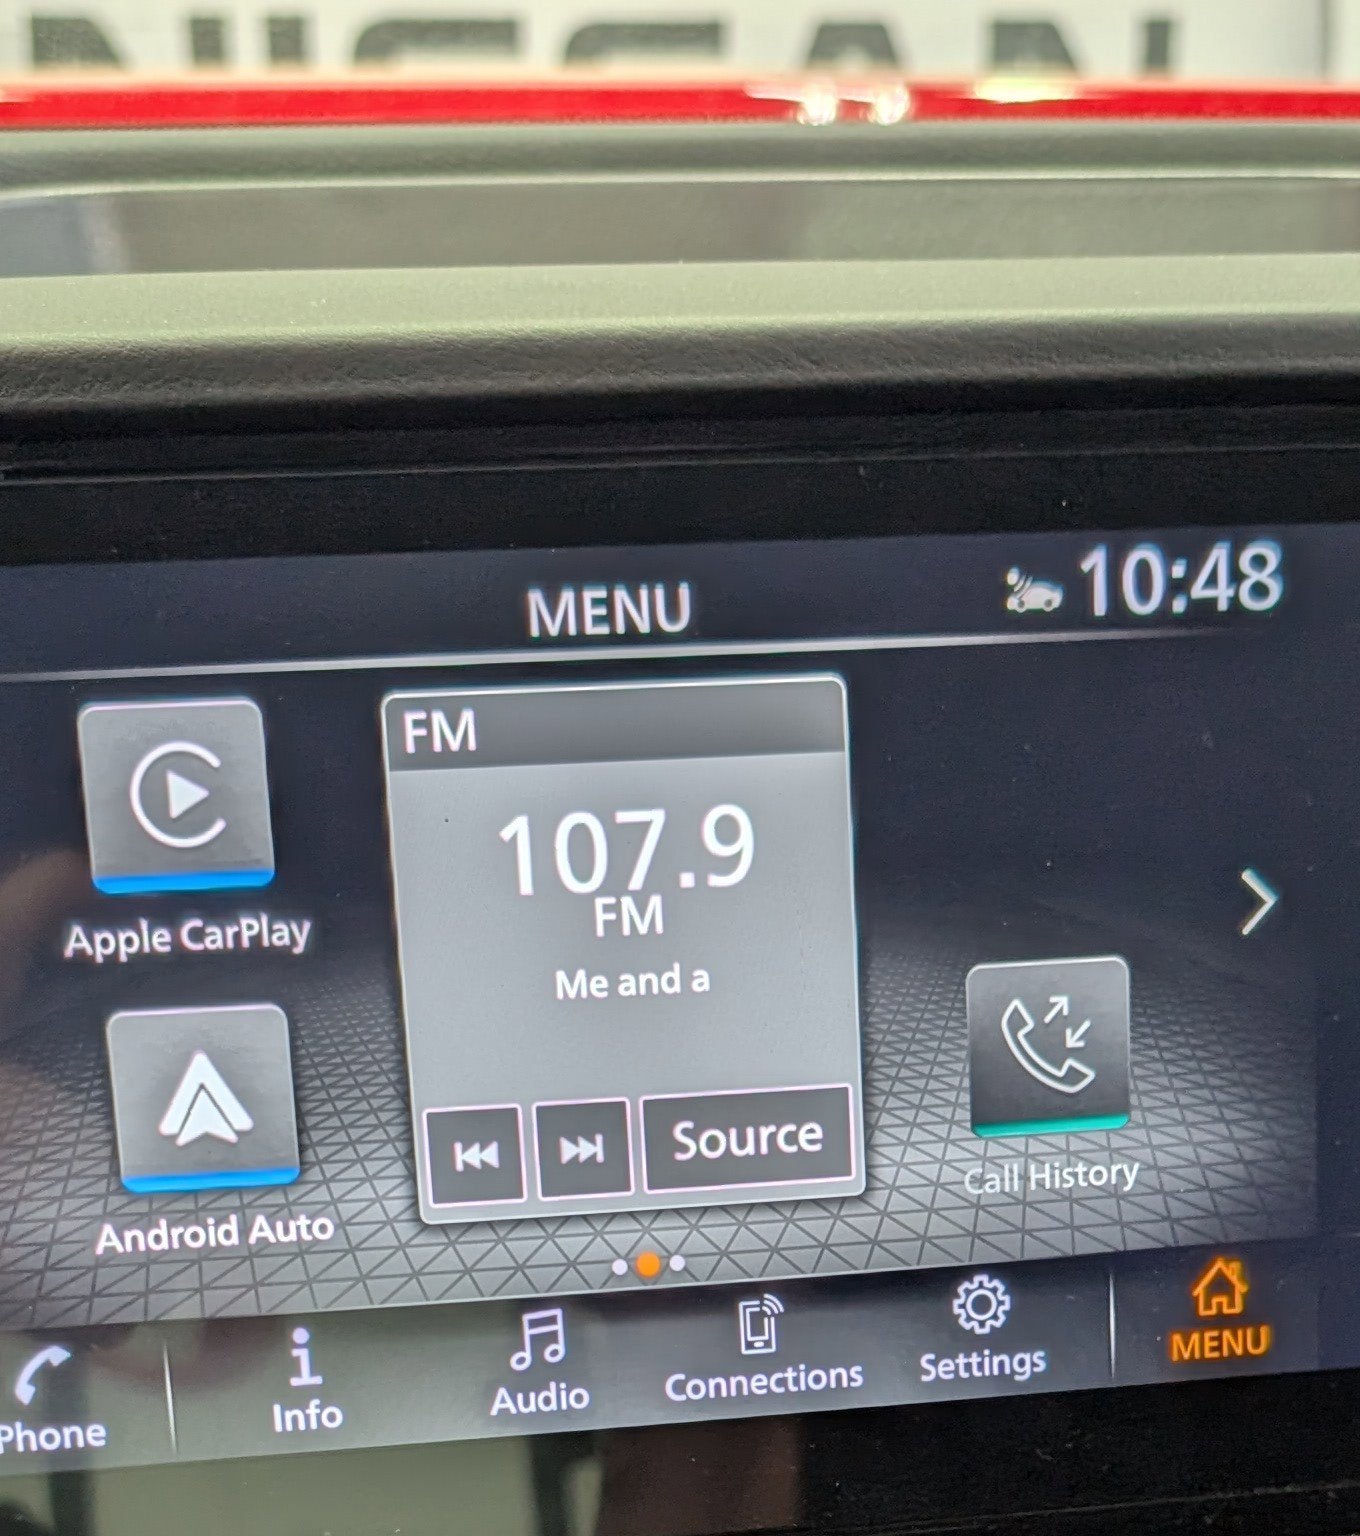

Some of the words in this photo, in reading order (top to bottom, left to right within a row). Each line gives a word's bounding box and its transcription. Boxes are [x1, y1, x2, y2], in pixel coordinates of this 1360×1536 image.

[1079, 541, 1285, 619] 10:48
[526, 583, 696, 638] MENU
[403, 709, 478, 753] FM
[499, 803, 755, 896] 107.9
[595, 894, 664, 937] FM
[64, 917, 172, 963] Apple
[181, 914, 311, 953] CarPlay
[555, 970, 609, 1000] Me
[618, 963, 681, 997] and
[692, 969, 710, 993] a
[673, 1119, 824, 1162] Source
[963, 1164, 1020, 1195] Call
[1029, 1159, 1140, 1192] History
[95, 1214, 239, 1255] Android
[248, 1212, 335, 1247] Auto
[1169, 1325, 1272, 1363] MENU
[665, 1365, 864, 1402] Connections
[920, 1350, 1047, 1384] Settings
[271, 1402, 344, 1433] Info
[490, 1383, 590, 1417] Audio
